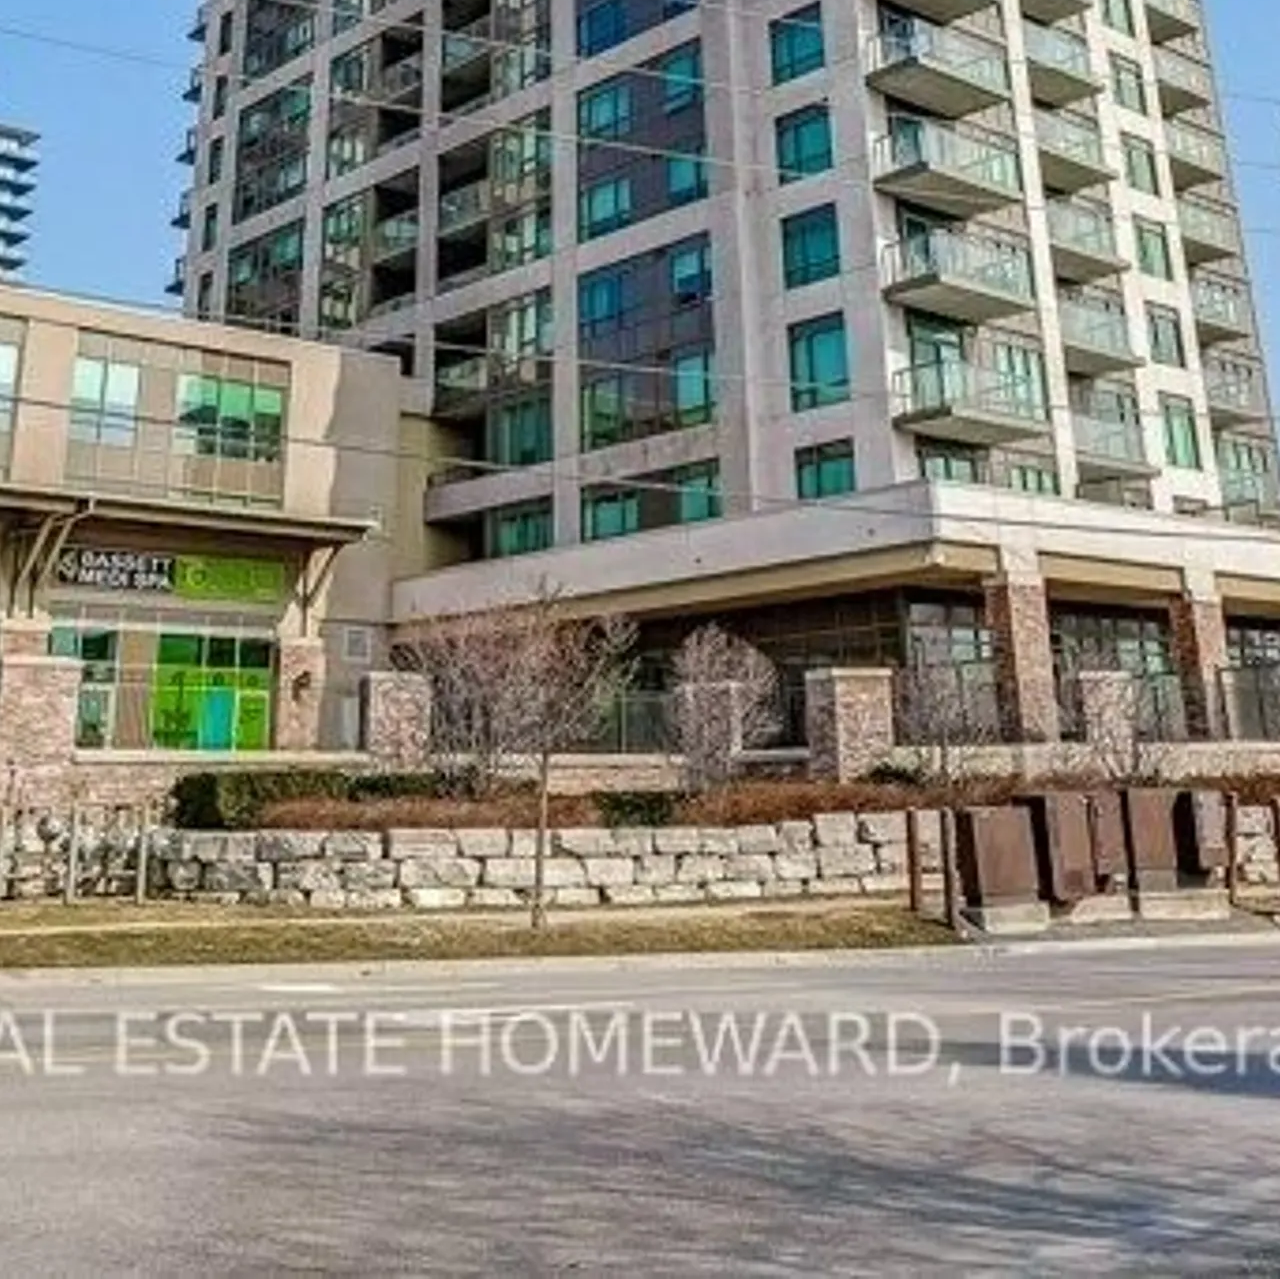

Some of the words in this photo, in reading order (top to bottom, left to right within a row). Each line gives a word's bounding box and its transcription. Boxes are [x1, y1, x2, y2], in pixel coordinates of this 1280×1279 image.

[81, 550, 173, 571] BASSETT
[77, 569, 129, 589] MEDI
[134, 572, 170, 591] SPA
